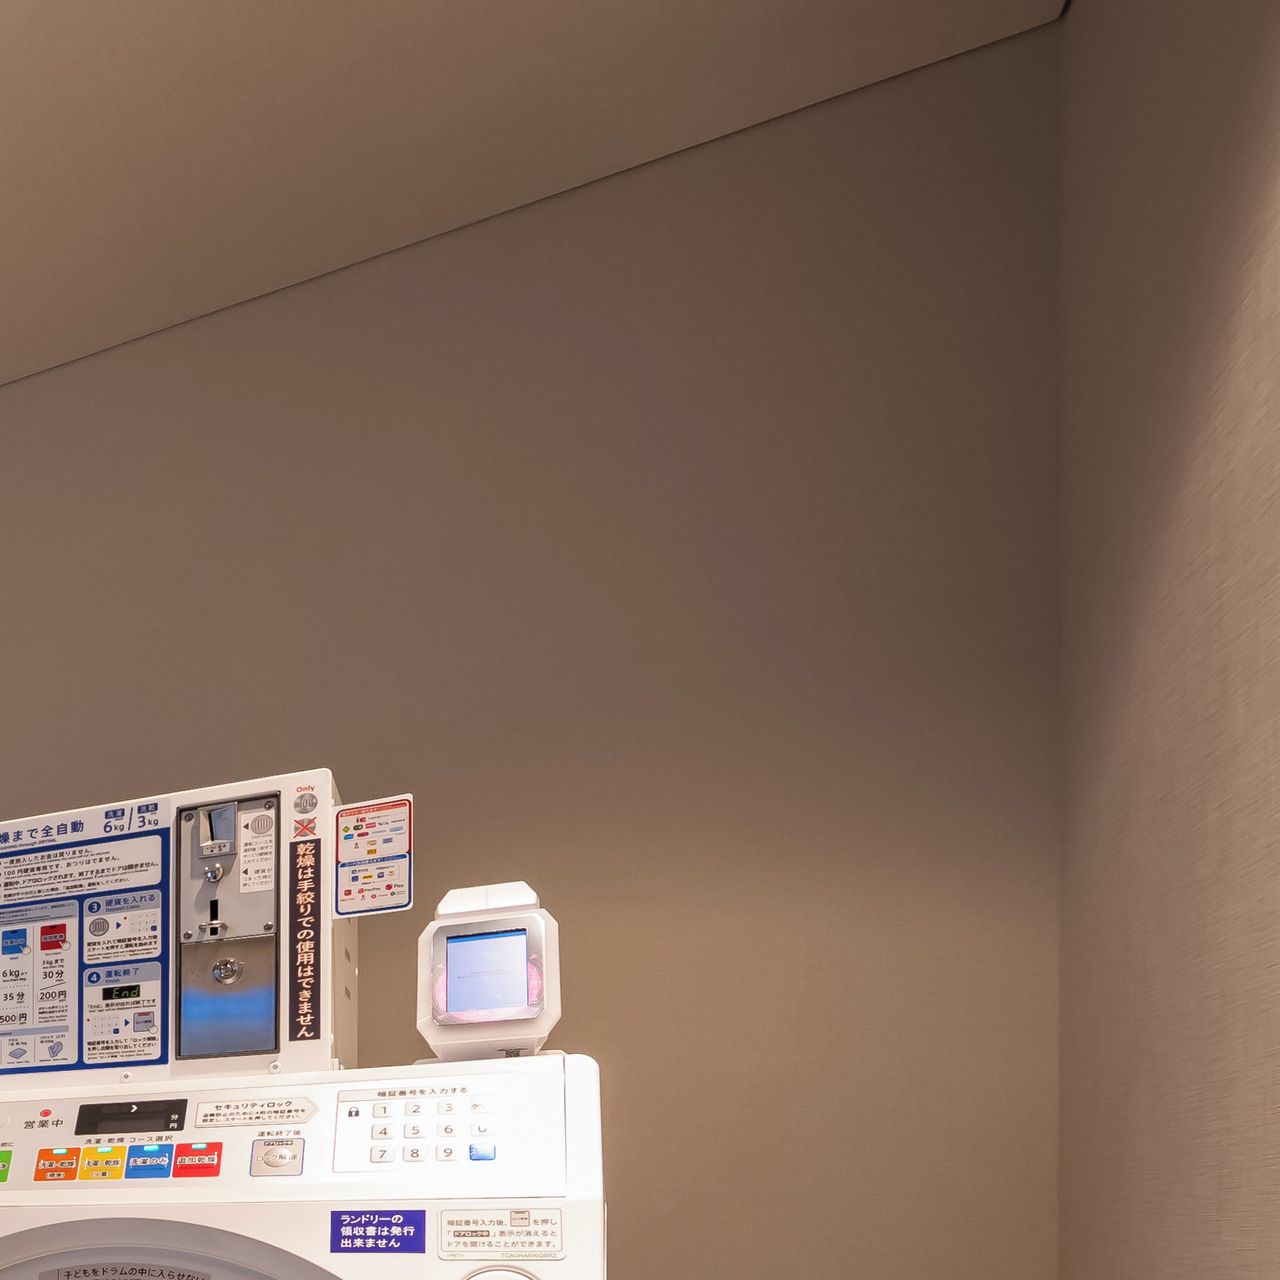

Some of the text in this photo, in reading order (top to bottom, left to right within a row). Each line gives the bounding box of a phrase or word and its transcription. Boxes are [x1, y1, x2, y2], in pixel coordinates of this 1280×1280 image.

[296, 785, 315, 793] Only
[105, 894, 156, 907] 硬貨を入れる
[90, 902, 98, 911] 3
[296, 843, 316, 1038] 乾燥は手絞りでの使用はできません
[43, 969, 64, 979] 30分
[90, 973, 97, 983] 4
[105, 967, 140, 979] 運転終了
[3, 991, 25, 1001] 35分
[40, 990, 67, 1000] 200円
[112, 987, 140, 999] End
[0, 1013, 27, 1023] 500円
[377, 1087, 468, 1097] 暗証番号を入力する
[214, 1101, 293, 1111] セキュリティロック
[382, 1106, 387, 1115] 1
[412, 1105, 420, 1113] 2
[446, 1103, 453, 1112] 3
[24, 1119, 64, 1129] 営業中
[379, 1127, 387, 1136] 4
[412, 1126, 420, 1135] 5
[444, 1125, 453, 1134] 6
[379, 1150, 387, 1159] 7
[410, 1149, 419, 1158] 8
[444, 1148, 453, 1157] 9
[340, 1214, 403, 1224] ランドリーの
[533, 1219, 557, 1227] を押し
[340, 1226, 415, 1236] 領収書は発行
[340, 1238, 401, 1248] 出来ません
[447, 1240, 557, 1249] ドアを開けることができます。
